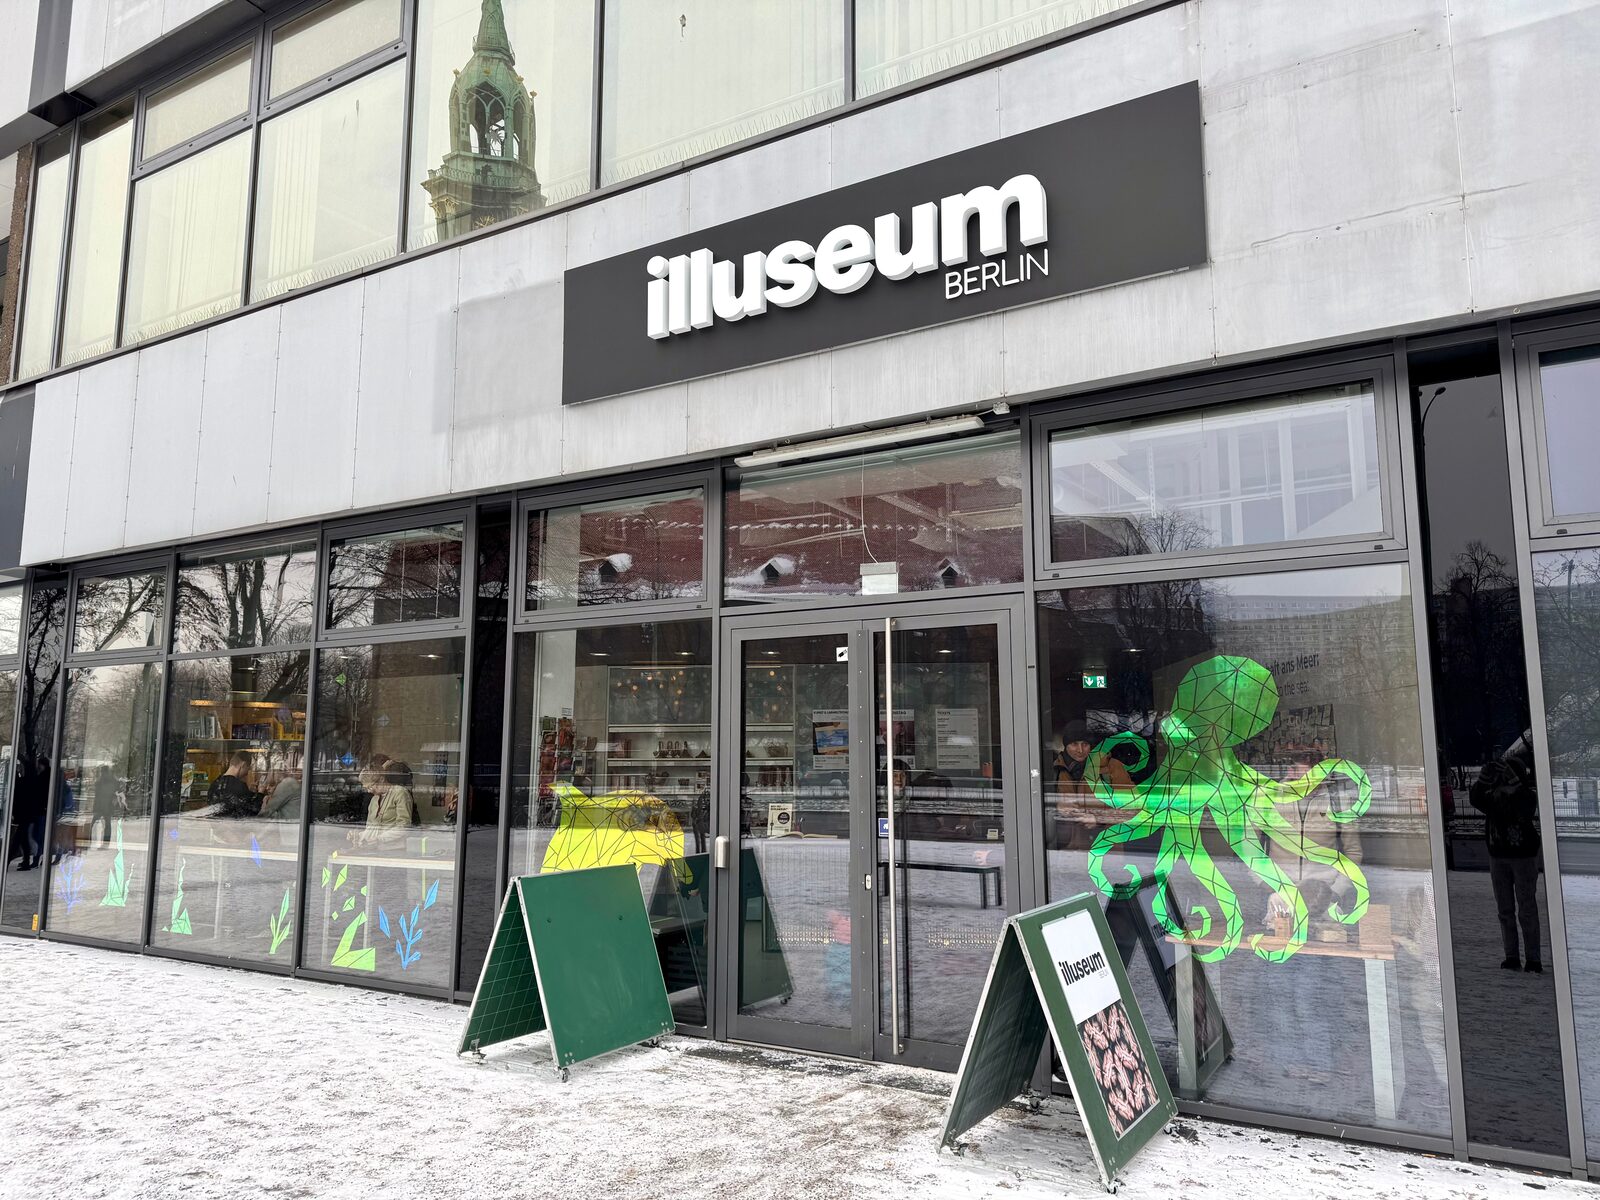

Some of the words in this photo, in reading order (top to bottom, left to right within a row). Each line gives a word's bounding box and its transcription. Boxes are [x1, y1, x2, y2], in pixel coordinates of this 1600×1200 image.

[647, 174, 1048, 339] illuseum
[945, 248, 1048, 300] BERLIN
[1058, 951, 1106, 986] illuseum
